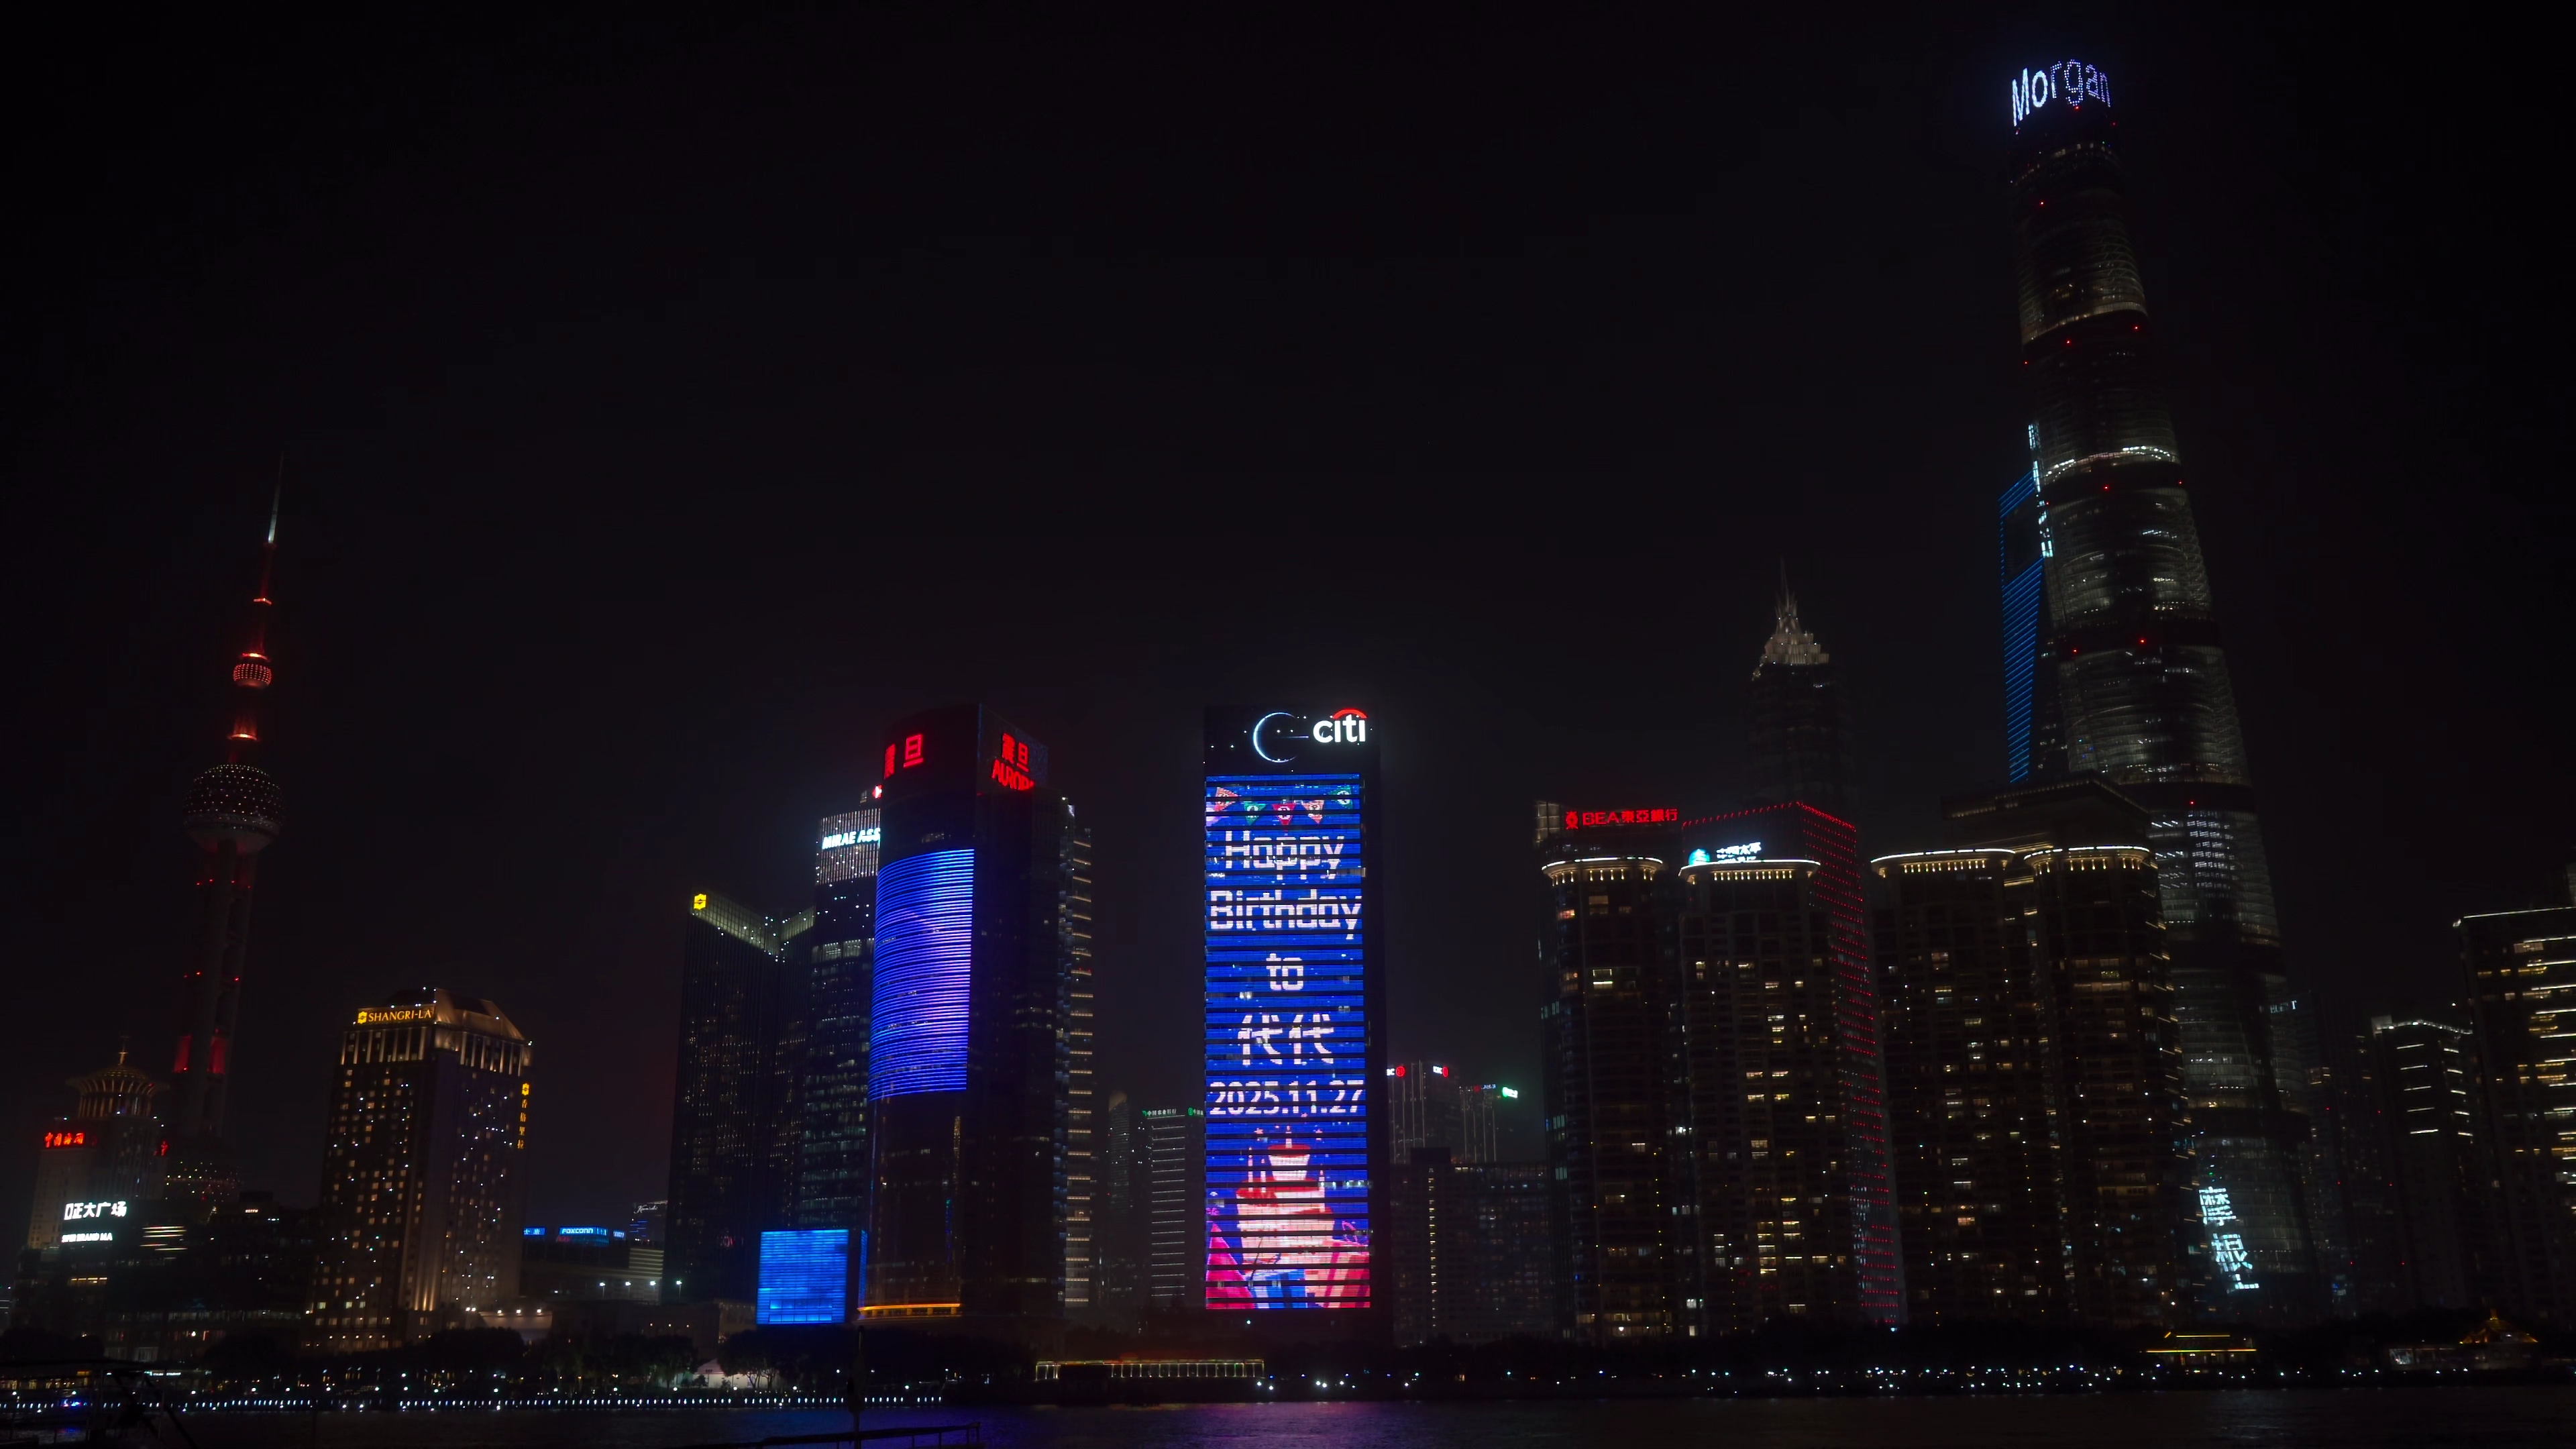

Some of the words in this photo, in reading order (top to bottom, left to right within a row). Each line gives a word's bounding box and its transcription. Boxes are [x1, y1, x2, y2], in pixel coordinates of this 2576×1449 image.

[2012, 59, 2111, 126] Morgan
[1312, 714, 1366, 743] citi
[883, 734, 924, 780] 震旦
[1002, 733, 1029, 773] 震旦
[991, 759, 1034, 791] AUROR
[1582, 812, 1619, 826] BEA
[1621, 808, 1678, 824] 東亞銀行
[822, 831, 857, 850] MIRAE
[1226, 830, 1344, 880] Happy
[1210, 889, 1362, 940] Birthday
[1266, 953, 1304, 991] to
[368, 1009, 432, 1022] SHANGRI-LA
[1238, 1014, 1334, 1066] 代代
[1210, 1080, 1364, 1115] 2025.11.27
[517, 1099, 527, 1149] 香格里拉
